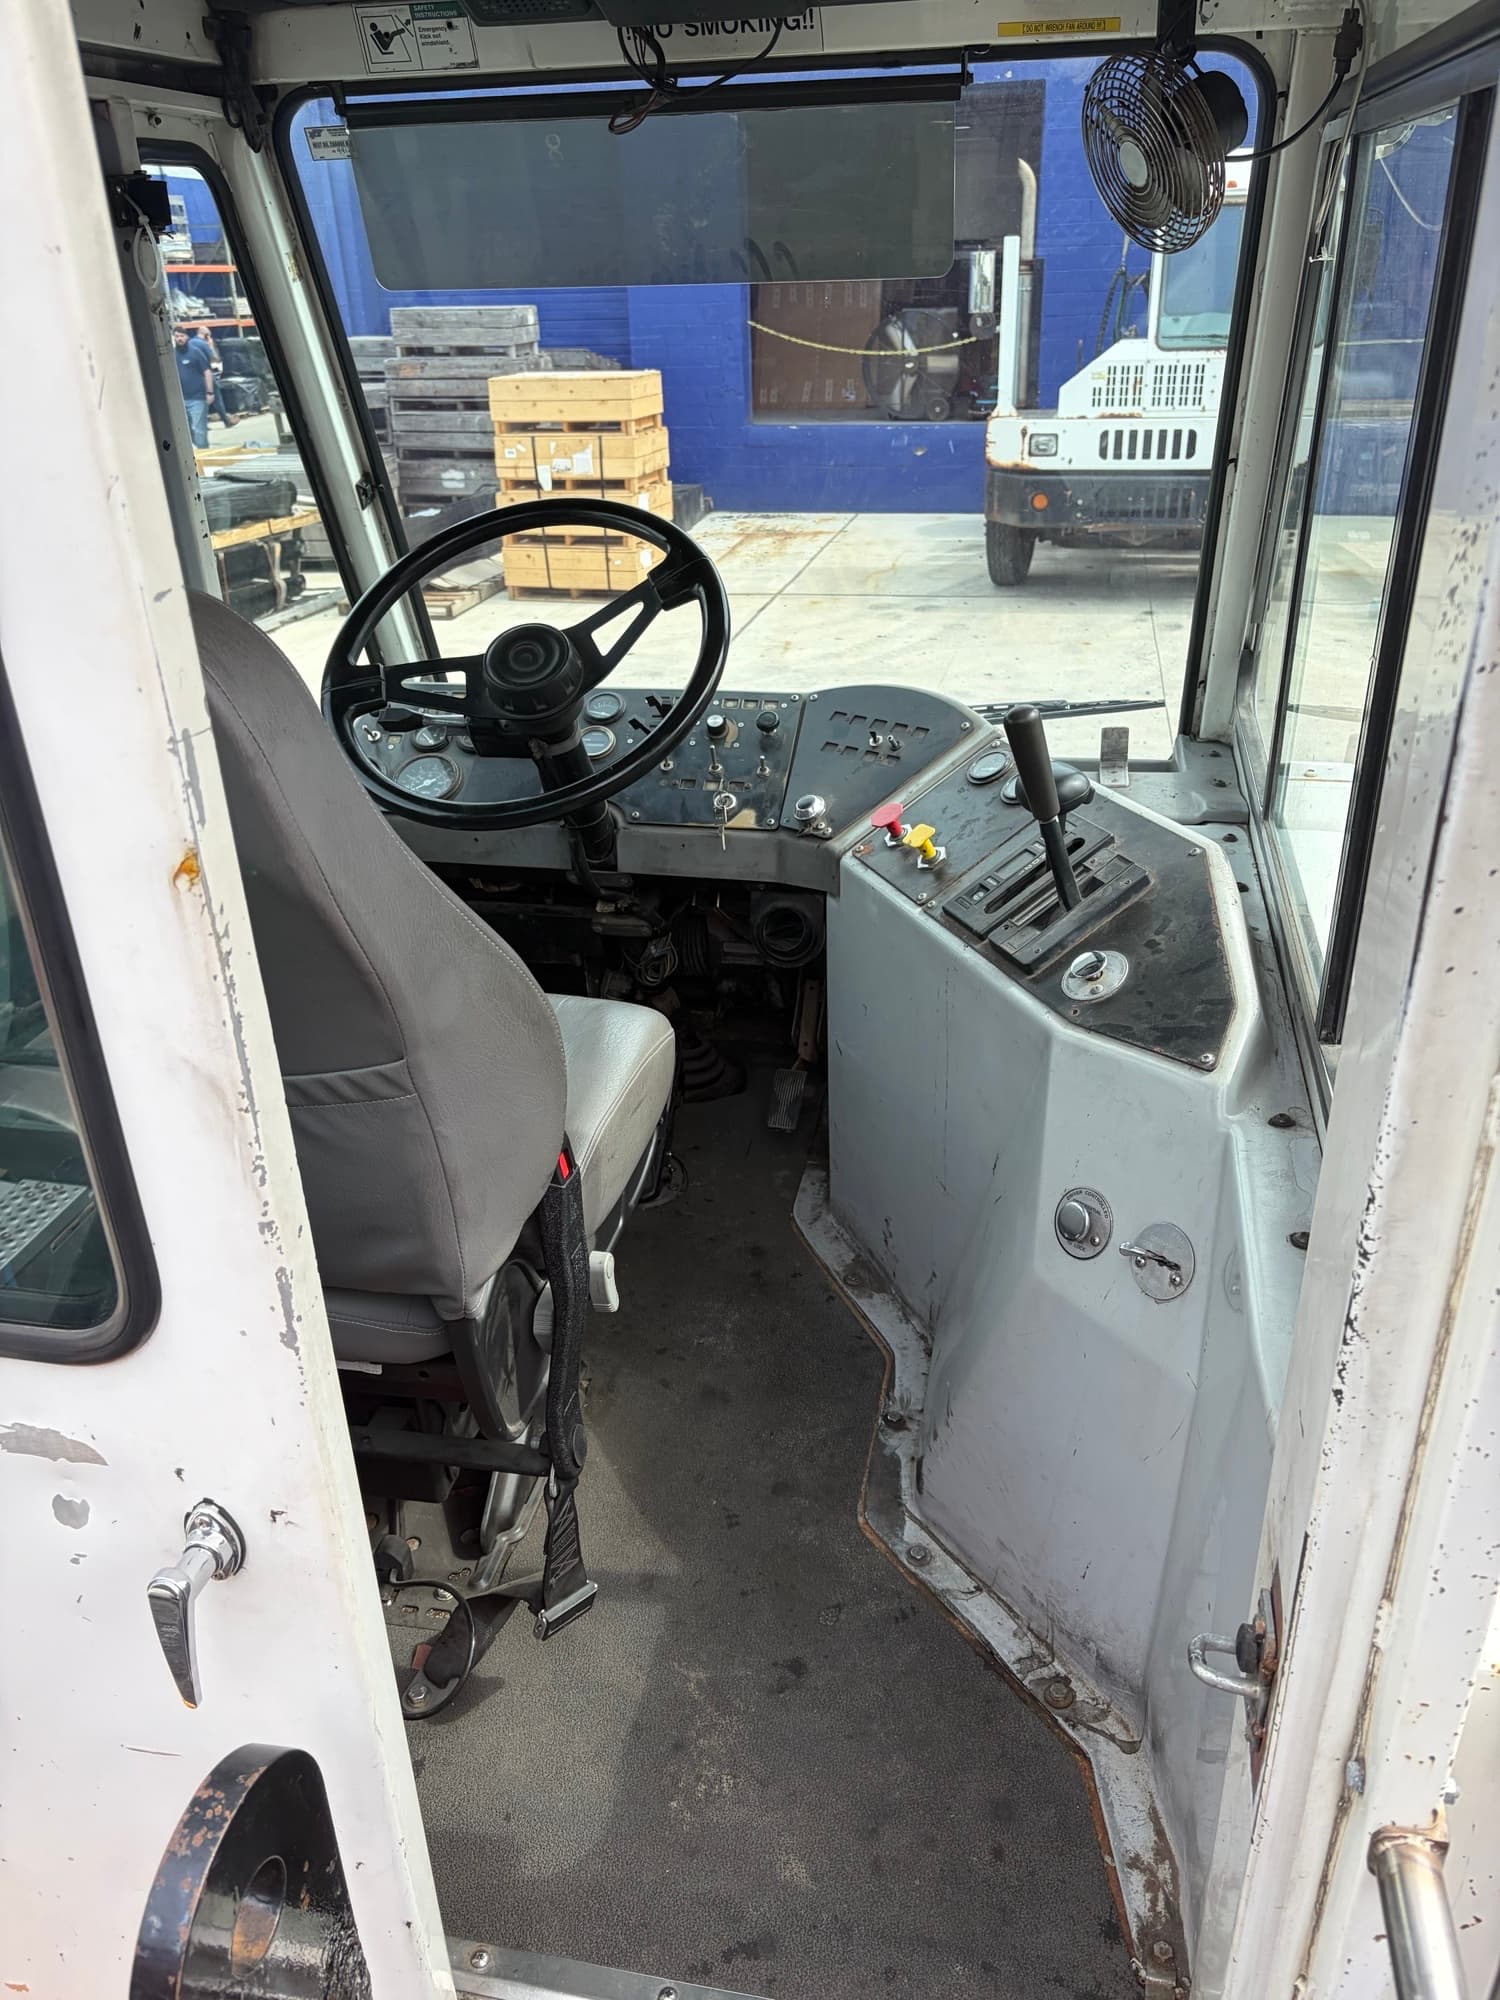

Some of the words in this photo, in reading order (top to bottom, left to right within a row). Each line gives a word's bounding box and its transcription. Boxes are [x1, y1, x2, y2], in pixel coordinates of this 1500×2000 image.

[414, 10, 458, 18] INSTRUCTIONS
[1034, 23, 1044, 32] NOT
[1045, 22, 1065, 32] WRENCH
[1065, 22, 1076, 31] FAN
[1076, 21, 1095, 31] AROUND
[1066, 1190, 1083, 1201] DRIVER
[1084, 1190, 1109, 1219] CONTROLLED
